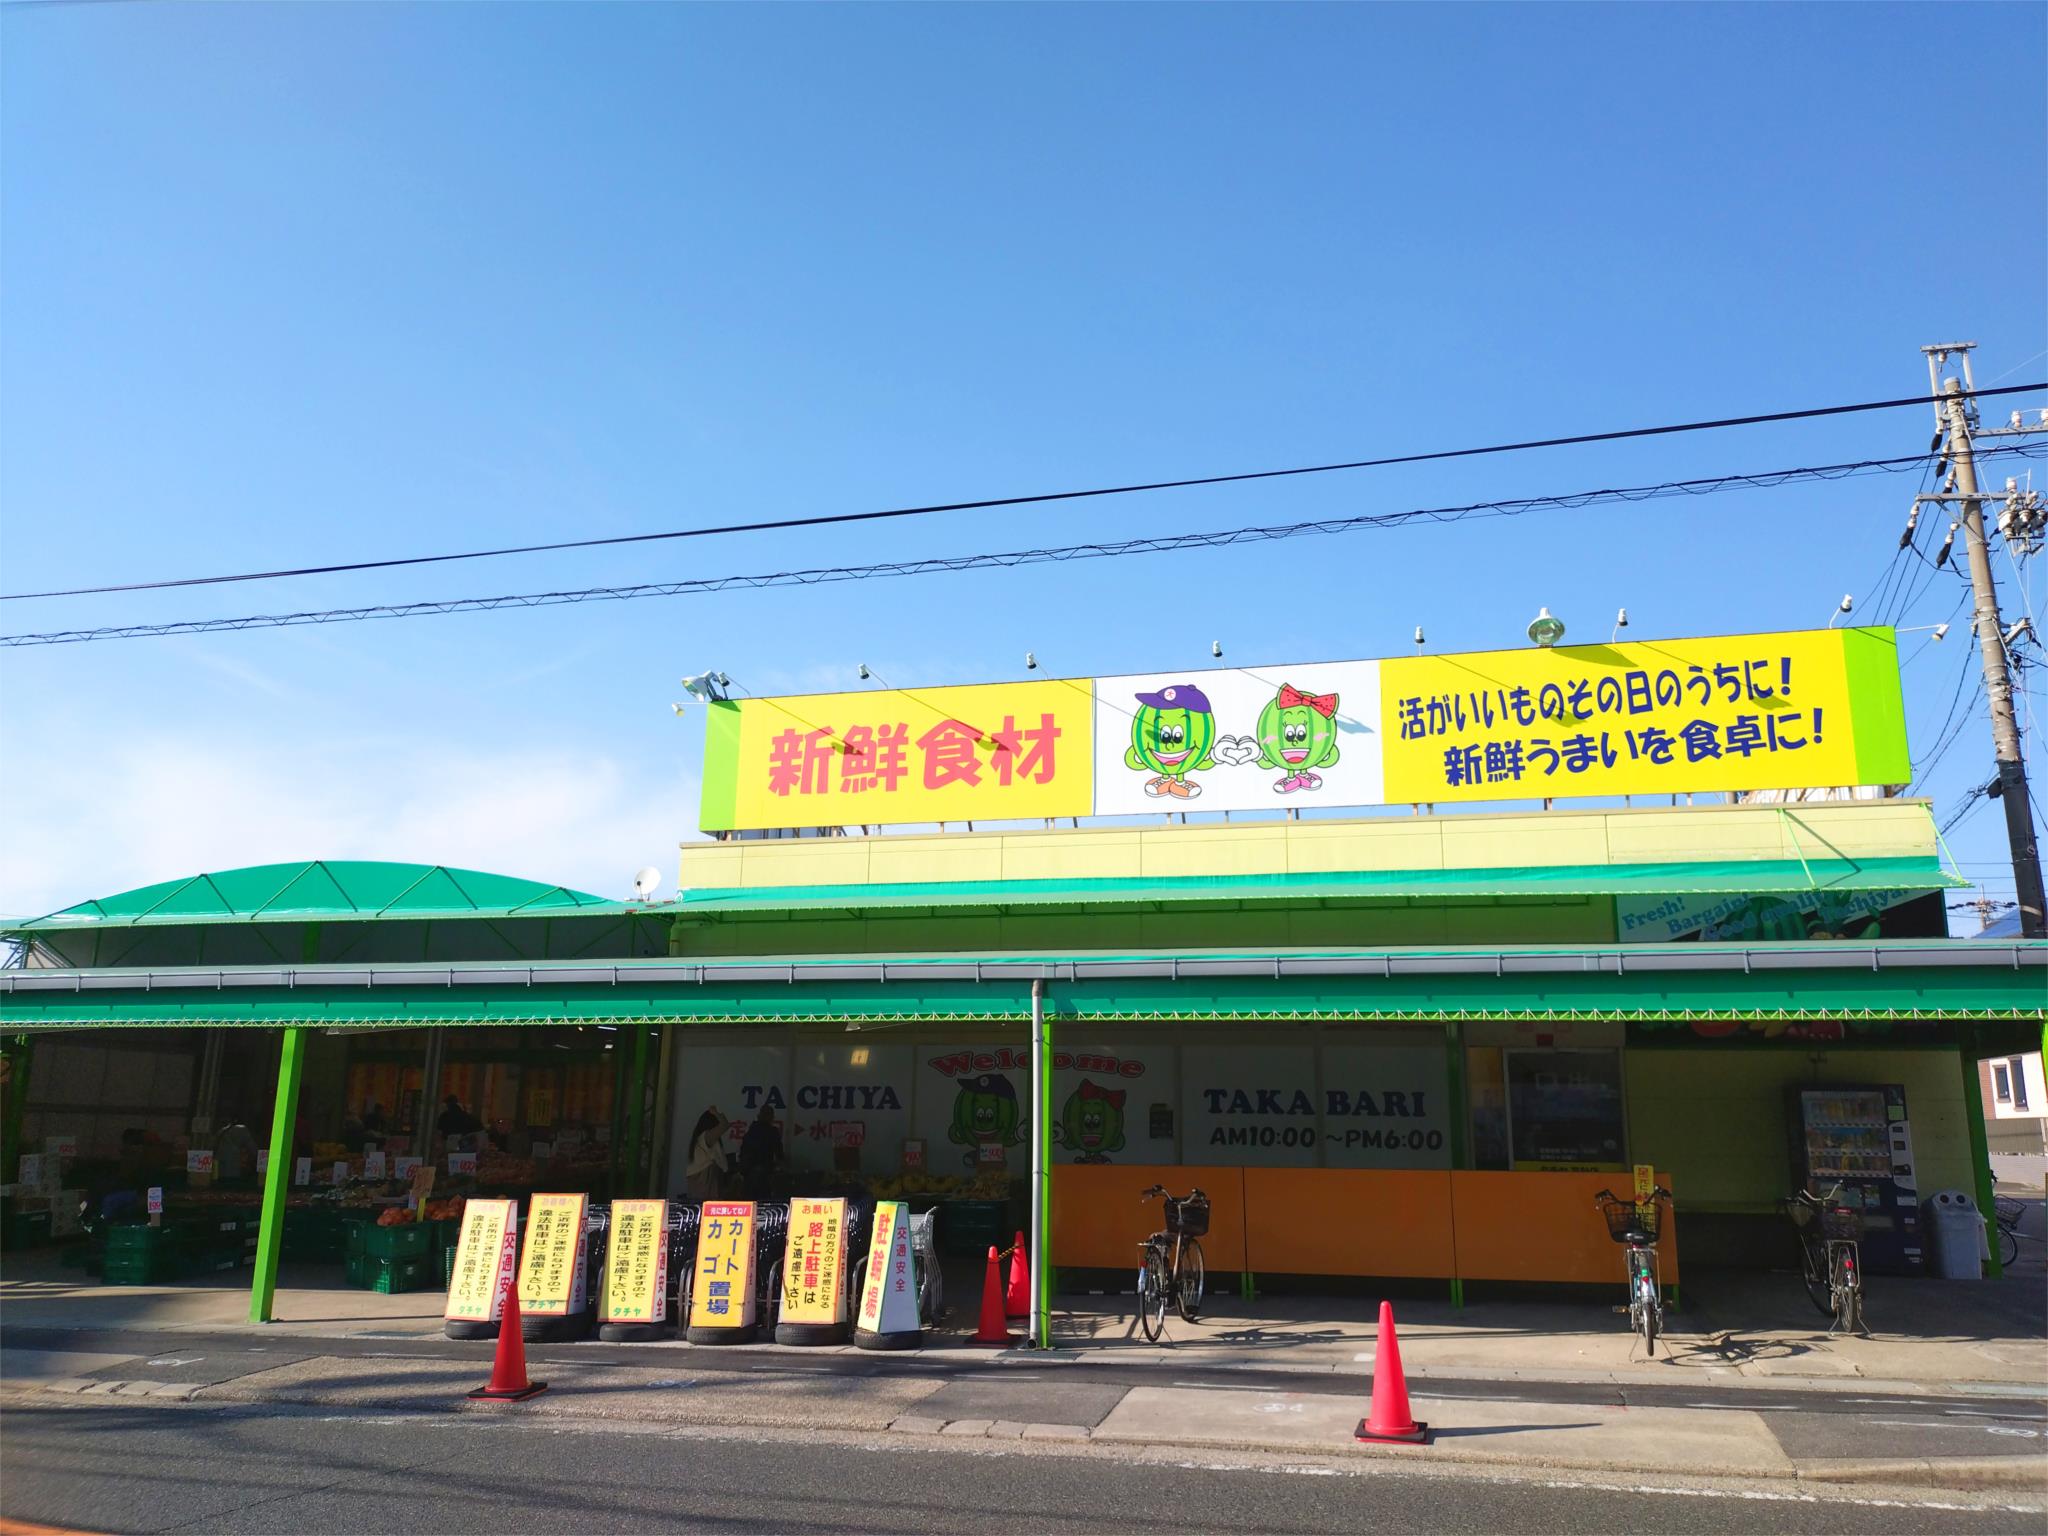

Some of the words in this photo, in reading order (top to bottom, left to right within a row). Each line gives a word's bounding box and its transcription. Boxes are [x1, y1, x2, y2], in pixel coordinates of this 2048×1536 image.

[768, 713, 1062, 796] 新鮮食材
[1622, 896, 1686, 930] Fresh!
[797, 1085, 902, 1110] CHIYA
[1204, 1089, 1315, 1115] TAKA
[1326, 1090, 1426, 1117] BARI
[1210, 1126, 1315, 1148] AM10:00
[802, 1205, 833, 1215] お願い
[703, 1218, 723, 1274] カゴ
[726, 1219, 744, 1275] カート
[804, 1222, 824, 1304] 路上駐車は
[895, 1227, 907, 1292] 交通安全
[788, 1235, 805, 1310] ご遠慮下さい
[706, 1281, 731, 1315] 置場
